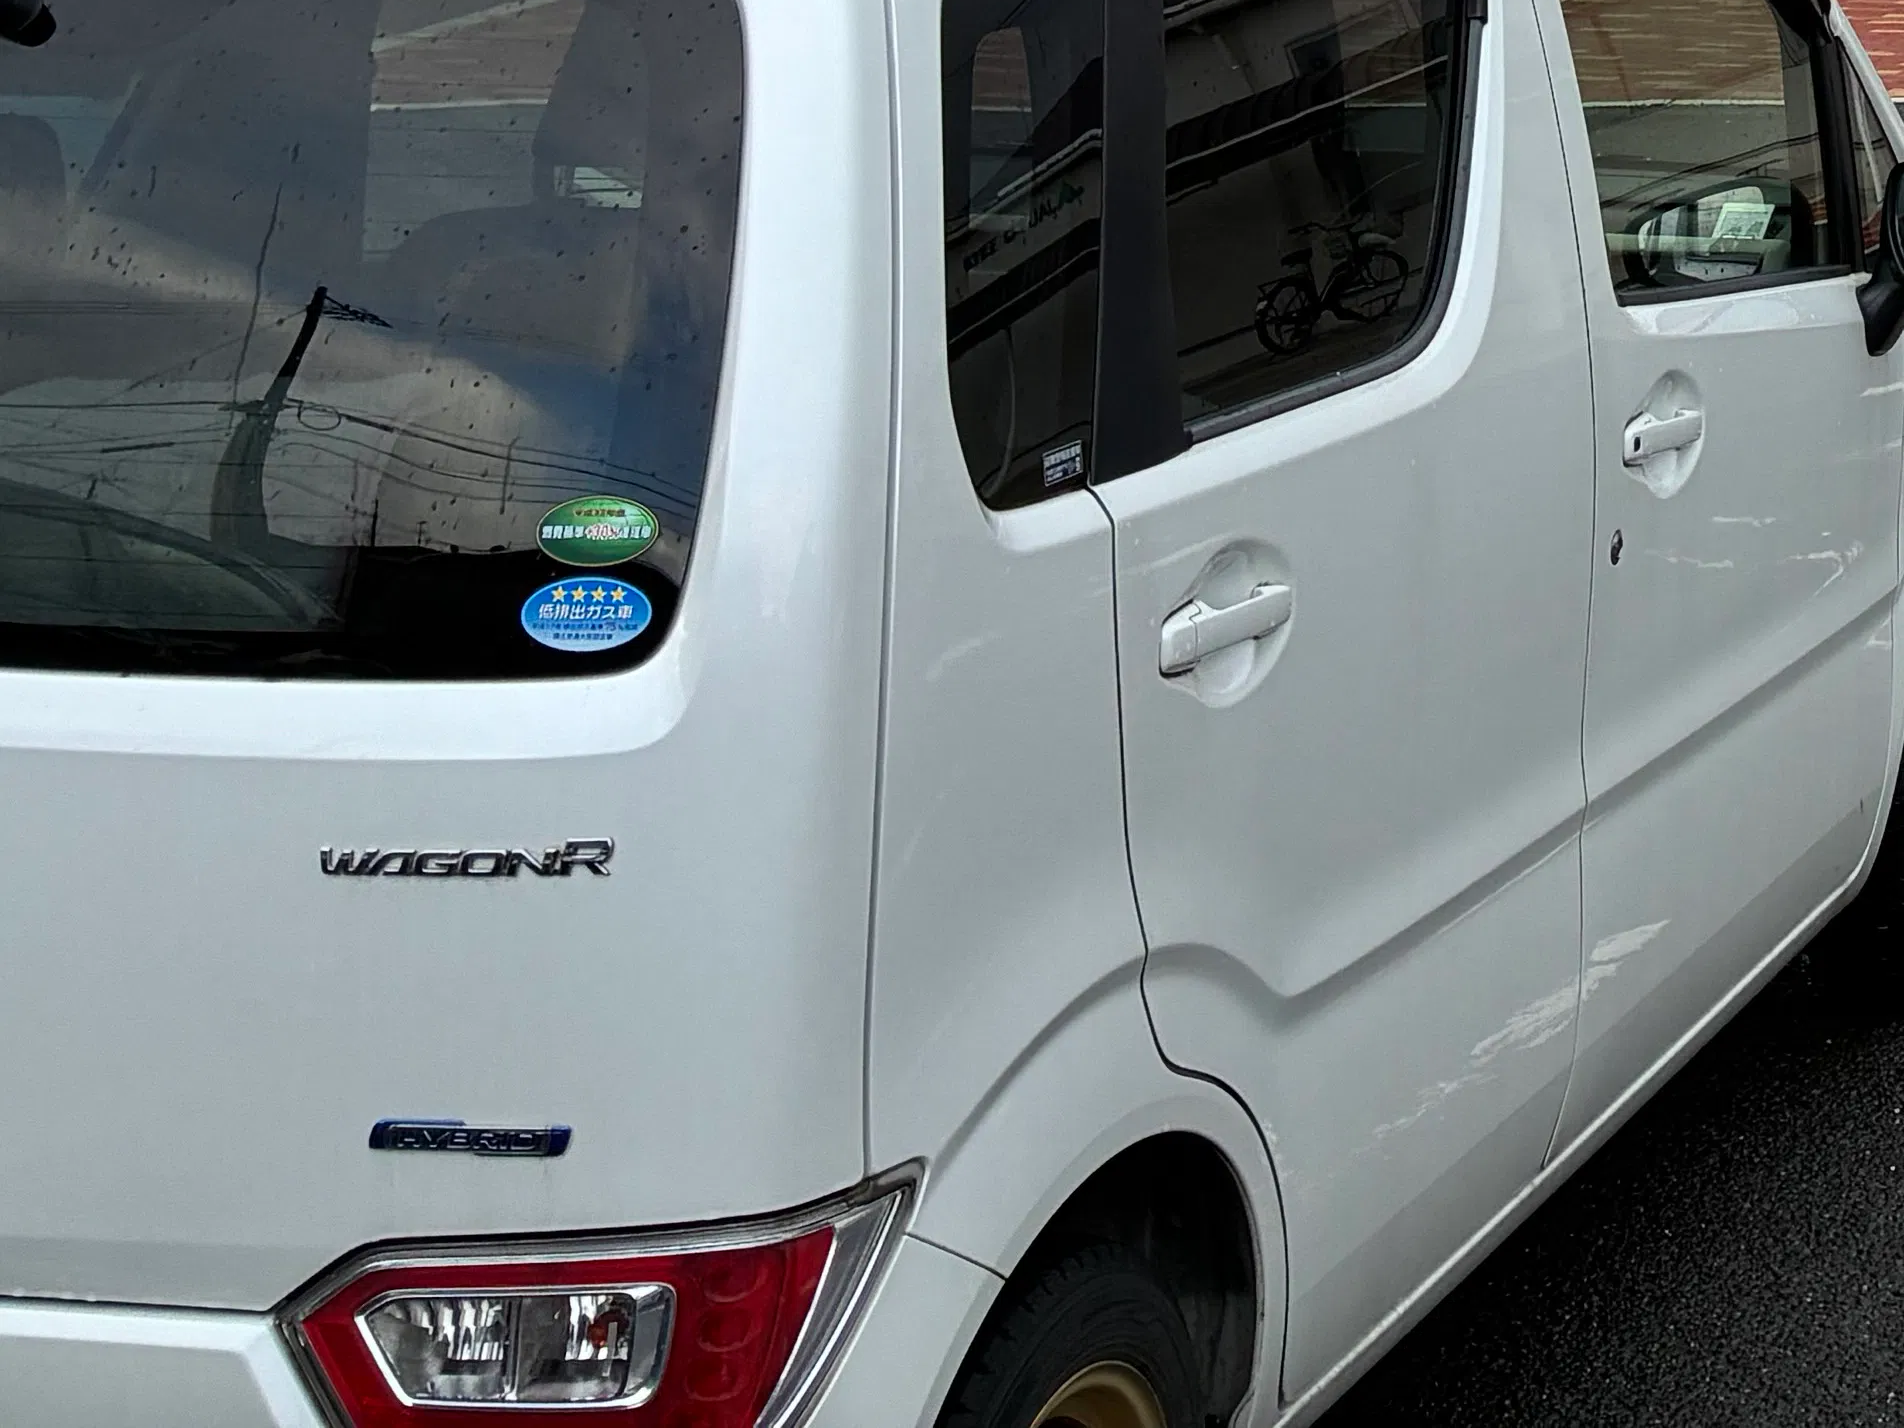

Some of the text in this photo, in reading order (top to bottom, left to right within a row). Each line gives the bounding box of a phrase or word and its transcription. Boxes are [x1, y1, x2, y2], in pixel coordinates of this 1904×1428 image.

[538, 603, 634, 620] 低排出ガス車
[397, 1129, 539, 1151] HYBRID
